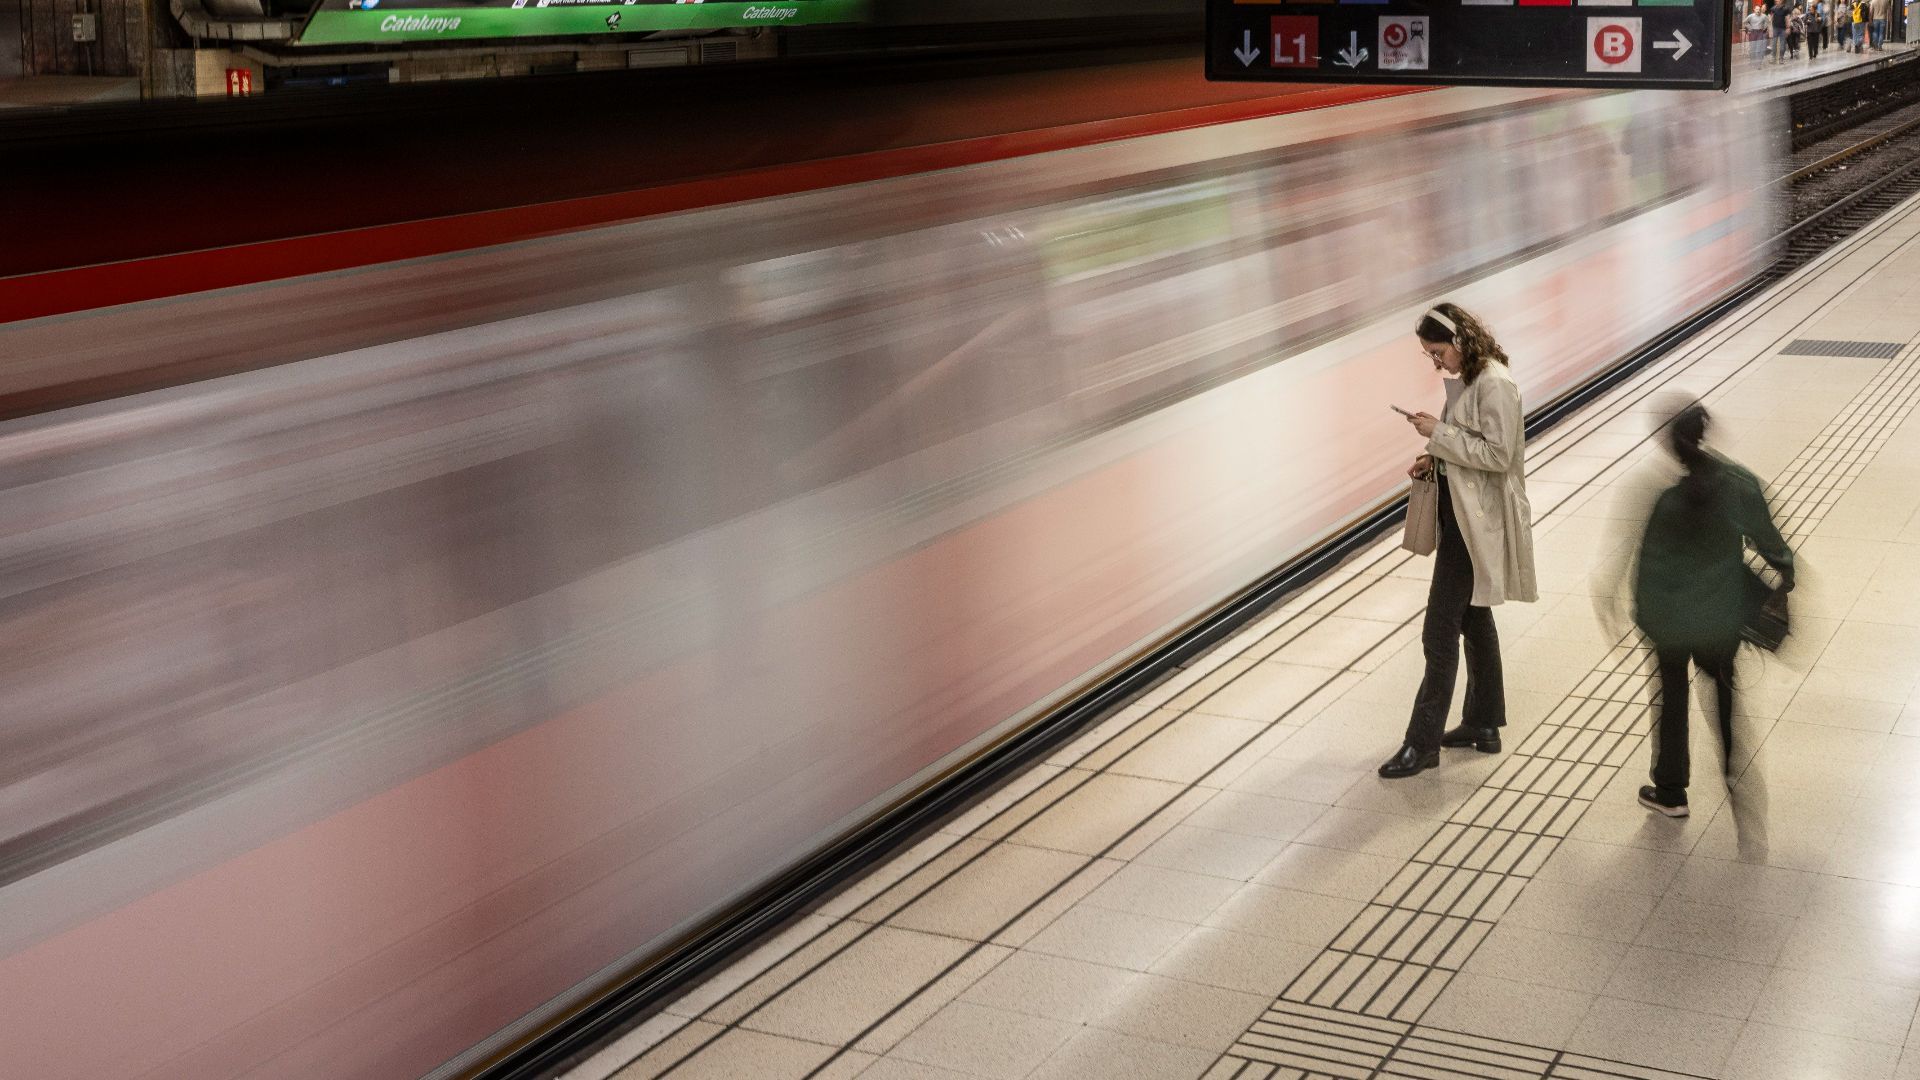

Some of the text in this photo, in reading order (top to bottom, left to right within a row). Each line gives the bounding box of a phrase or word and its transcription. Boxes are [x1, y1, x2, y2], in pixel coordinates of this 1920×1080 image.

[380, 14, 462, 33] Catalunya
[742, 6, 798, 21] Catalunya
[1274, 33, 1306, 64] L1
[1603, 31, 1627, 57] B
